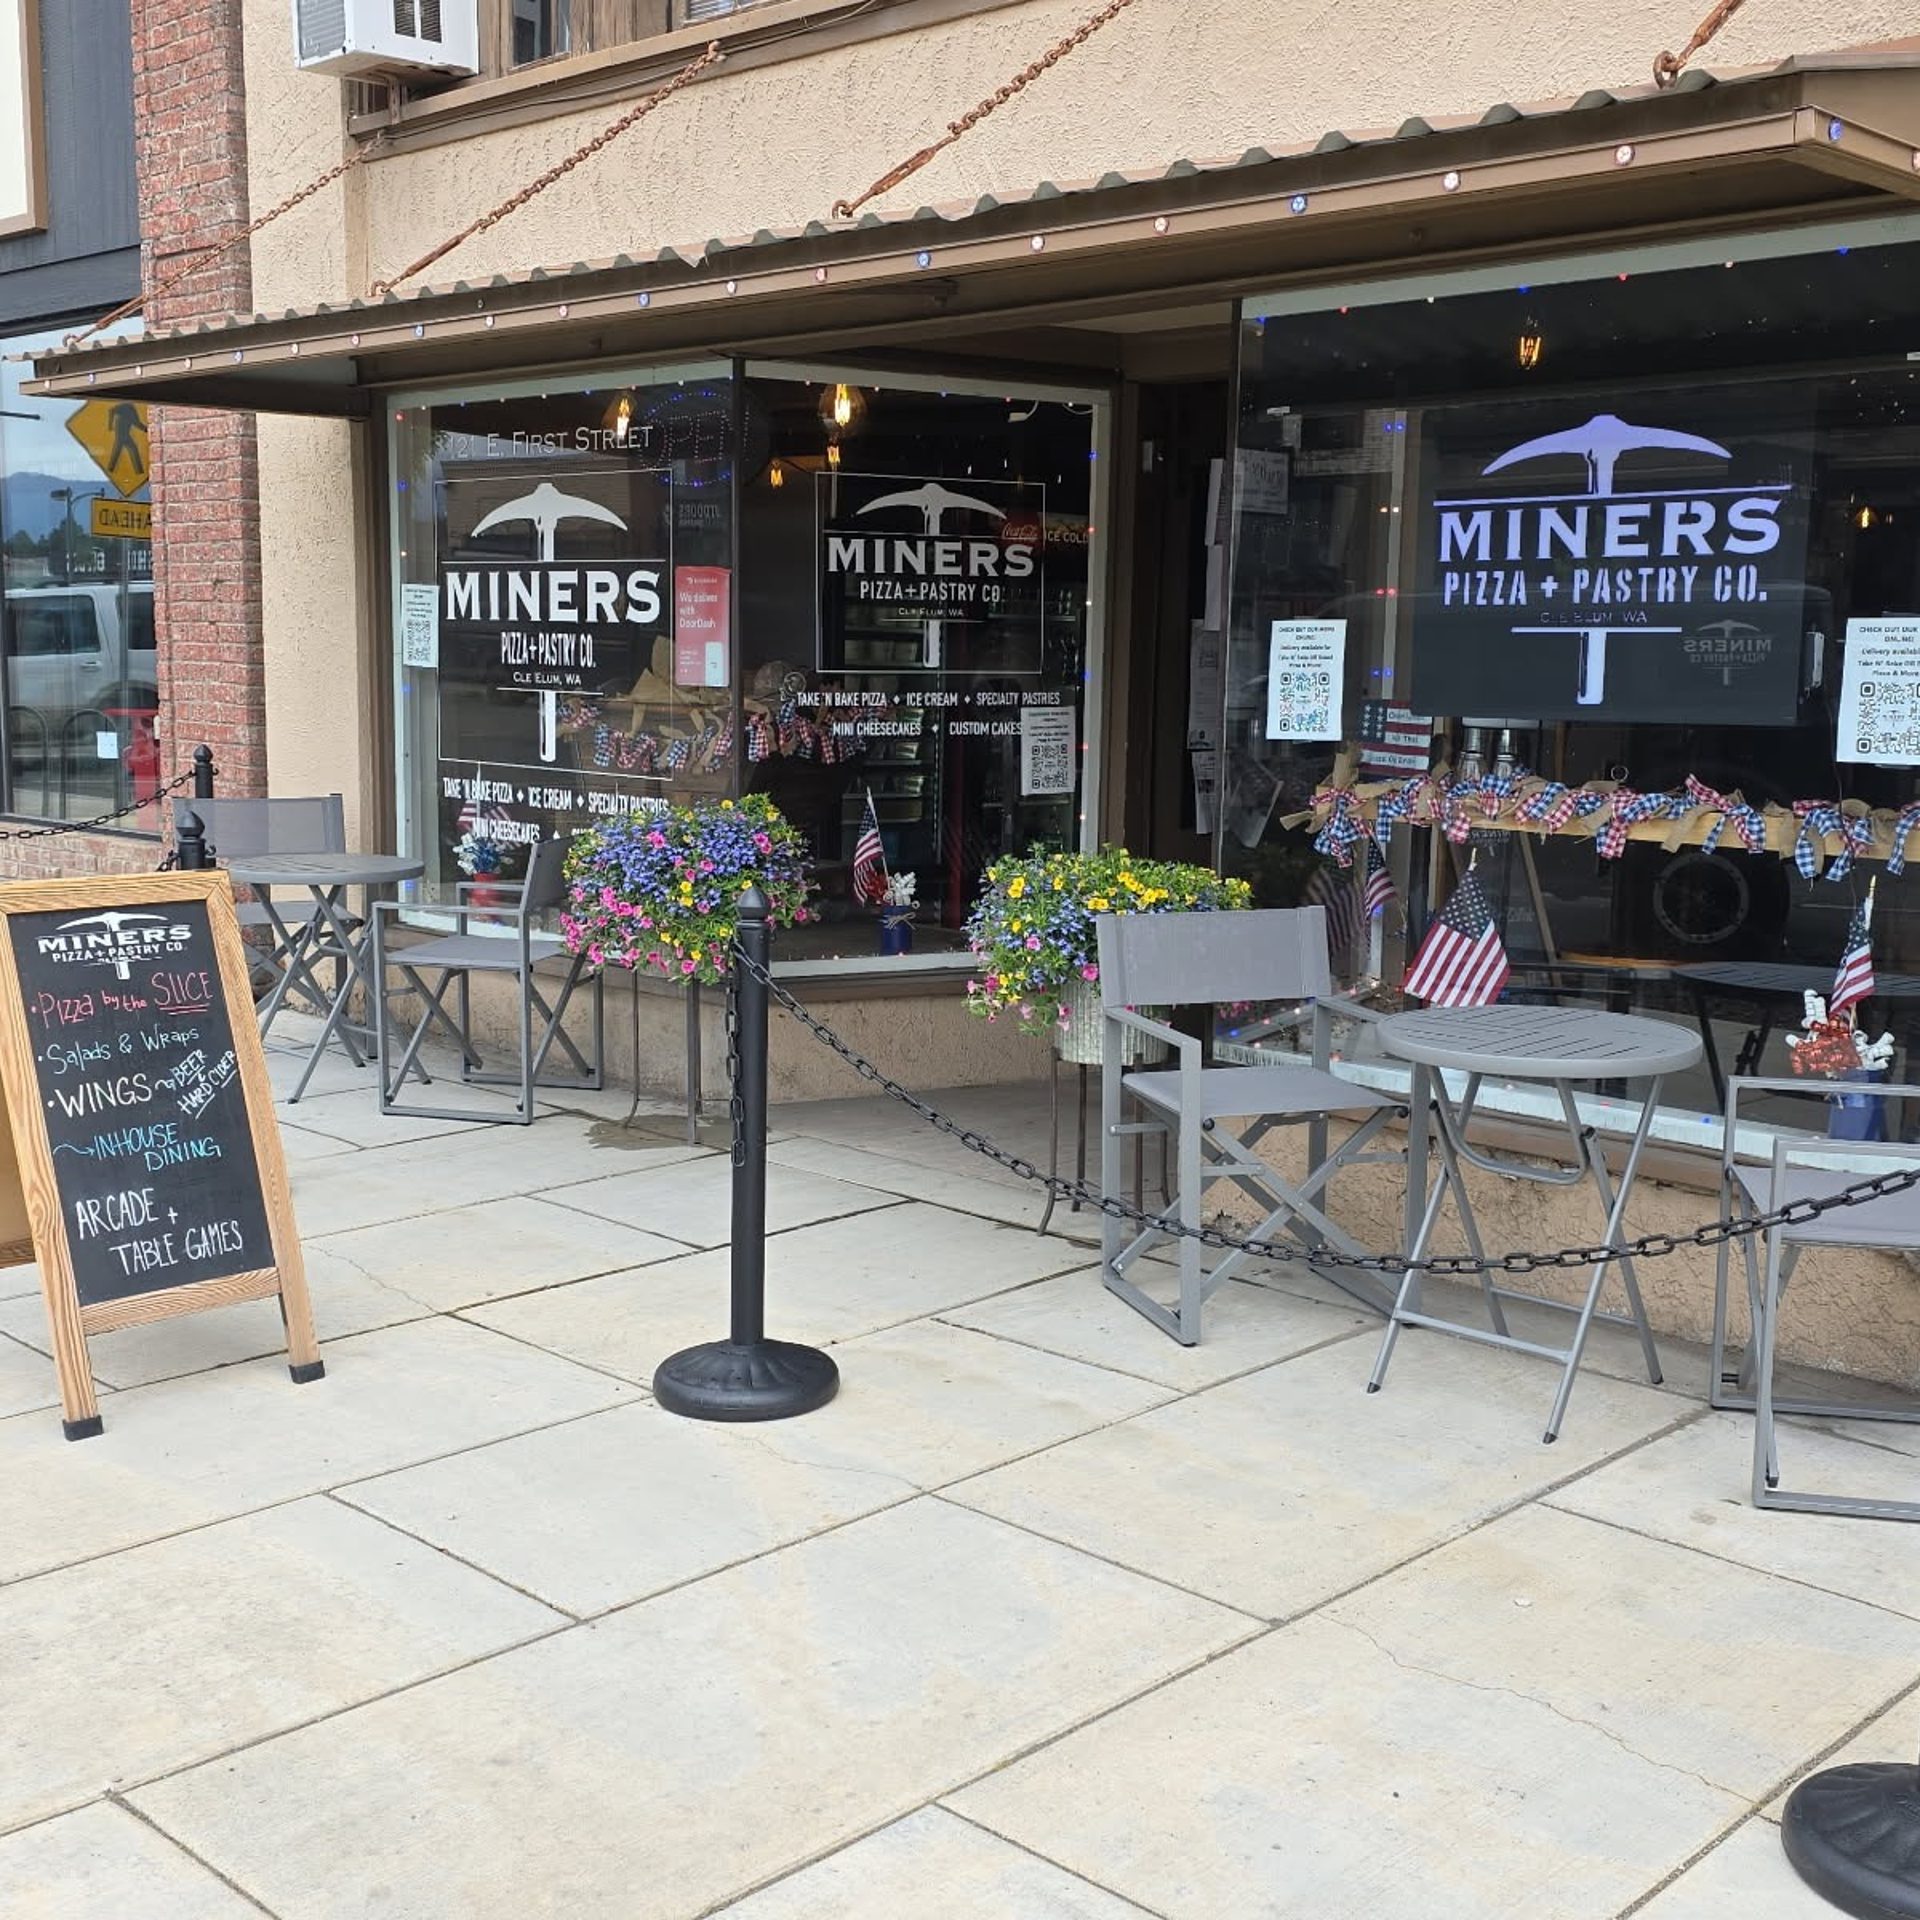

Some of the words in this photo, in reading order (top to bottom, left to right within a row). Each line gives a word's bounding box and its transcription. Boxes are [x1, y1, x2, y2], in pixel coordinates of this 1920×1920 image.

[513, 431, 568, 456] FIRST
[1438, 497, 1782, 562] MINERS
[827, 537, 1034, 577] MINERS
[446, 568, 661, 625] MINERS
[860, 581, 904, 599] PIZZA
[920, 581, 976, 602] PASTRY
[1444, 570, 1527, 606] PIZZA
[1573, 565, 1699, 605] PASTRY
[1713, 564, 1768, 602] CO.
[501, 631, 529, 665] PIZZA
[538, 632, 577, 666] PASTRY
[580, 633, 597, 668] CO.
[513, 671, 532, 682] CLE
[565, 672, 582, 685] WA
[797, 692, 820, 707] TAKE
[835, 692, 859, 707] BAKE
[861, 692, 887, 707] PIZZA
[906, 692, 922, 707] ICE
[924, 692, 958, 707] CREAM
[976, 692, 1019, 706] SPECIALTY
[1022, 691, 1061, 706] PASTRIES
[833, 721, 854, 736] MINI
[856, 721, 921, 736] CHEESECAKES
[949, 721, 989, 736] CUSTOM
[991, 721, 1022, 736] CAKES
[492, 781, 514, 804] PIZZA
[528, 786, 542, 809] ICE
[543, 787, 572, 811] CREAM
[38, 926, 192, 953] MINERS
[52, 950, 94, 963] PIZZA
[108, 943, 161, 957] PASTRY
[101, 989, 121, 1010] by
[122, 995, 148, 1012] the
[47, 1040, 112, 1075] Salads
[118, 1033, 132, 1054] &
[169, 1049, 208, 1087] BEER
[54, 1072, 153, 1119] WINGS
[176, 1082, 214, 1115] HARD
[207, 1050, 237, 1086] CIDER
[93, 1122, 178, 1161] INHOUSE
[143, 1136, 222, 1172] DINING
[75, 1187, 160, 1240] ARCADE
[108, 1232, 179, 1276] TABLE
[184, 1219, 244, 1261] GAMES
